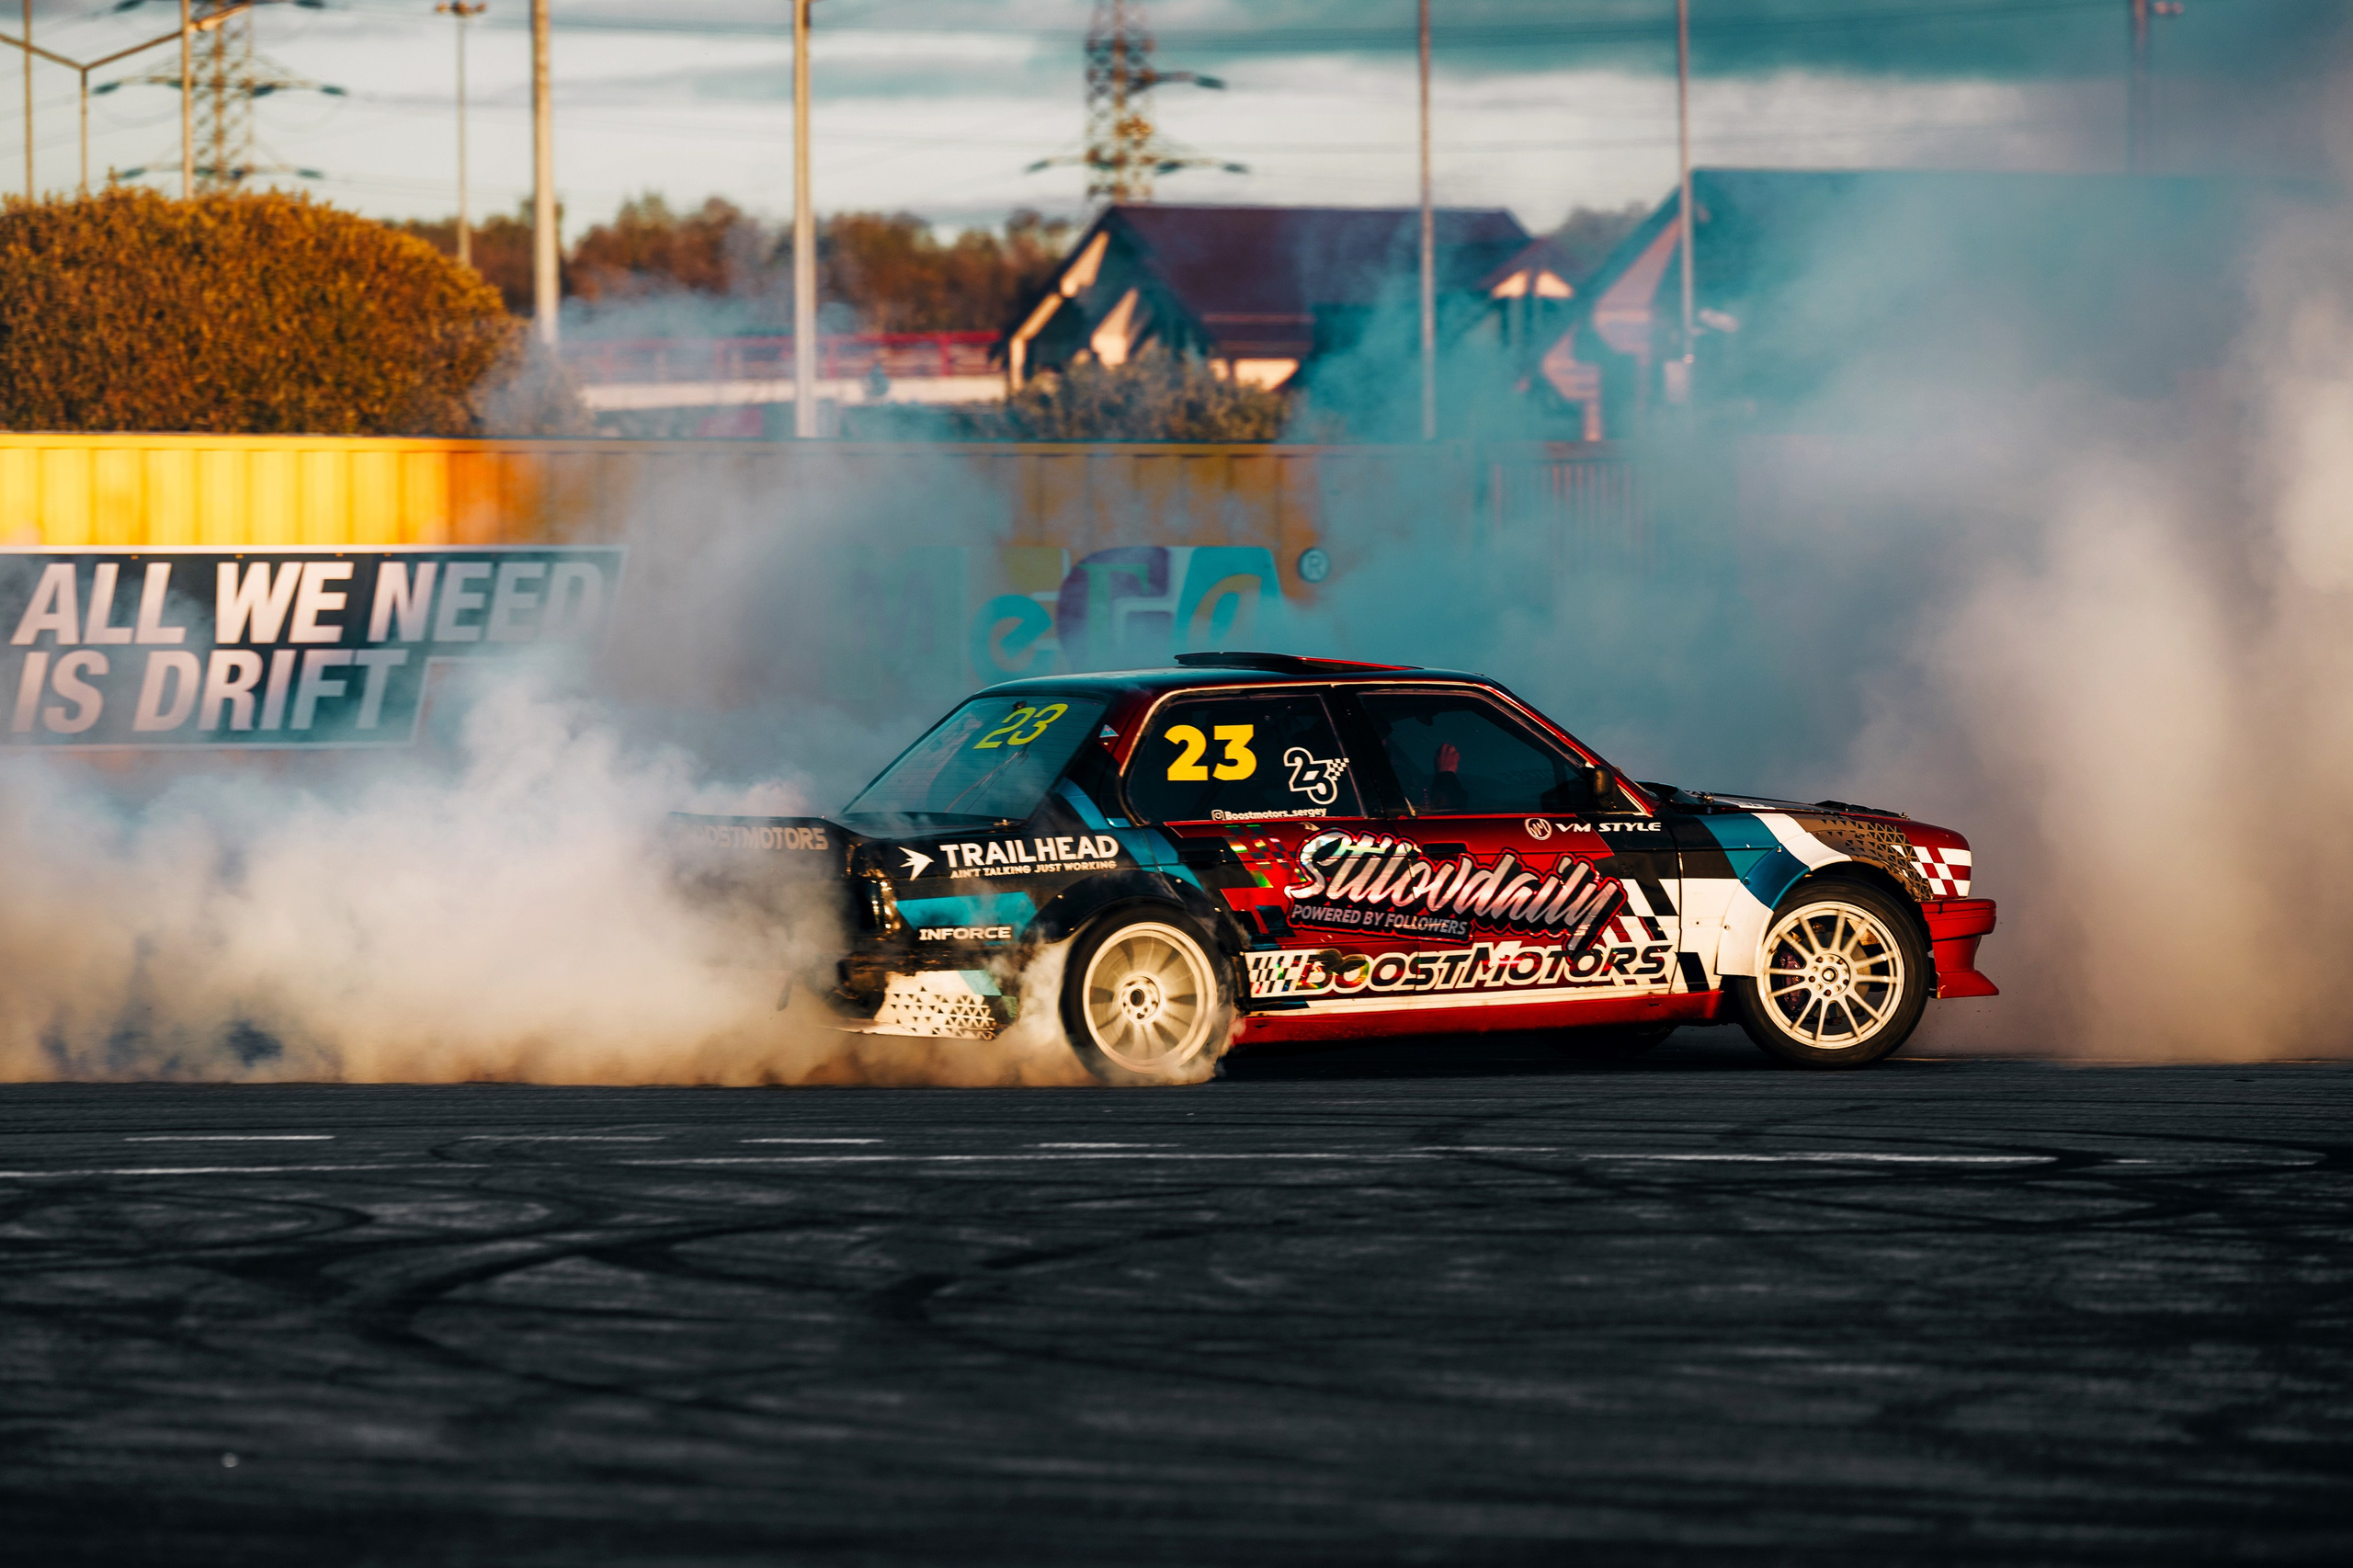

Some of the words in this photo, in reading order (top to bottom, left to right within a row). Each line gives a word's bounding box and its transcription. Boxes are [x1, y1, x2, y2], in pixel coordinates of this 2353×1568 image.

[11, 562, 187, 644] ALL
[215, 562, 355, 643] WE
[368, 562, 605, 642] NEED
[10, 649, 110, 734] IS
[131, 649, 410, 732] DRIFT
[972, 703, 1069, 749] 23
[1164, 724, 1257, 781] 23
[1283, 746, 1340, 805] 23
[1555, 823, 1592, 833] VM
[1598, 822, 1662, 832] STYLE
[938, 835, 1120, 868] TRAILHEAD
[949, 868, 981, 880] AIN'T
[982, 864, 1032, 877] TALKING
[1033, 864, 1063, 874] JUST
[1064, 860, 1118, 871] WORKING
[919, 926, 1012, 941] INFORCE
[1290, 903, 1362, 924] POWERED
[1363, 911, 1385, 926] BY
[1384, 913, 1468, 936] FOLLOWERS
